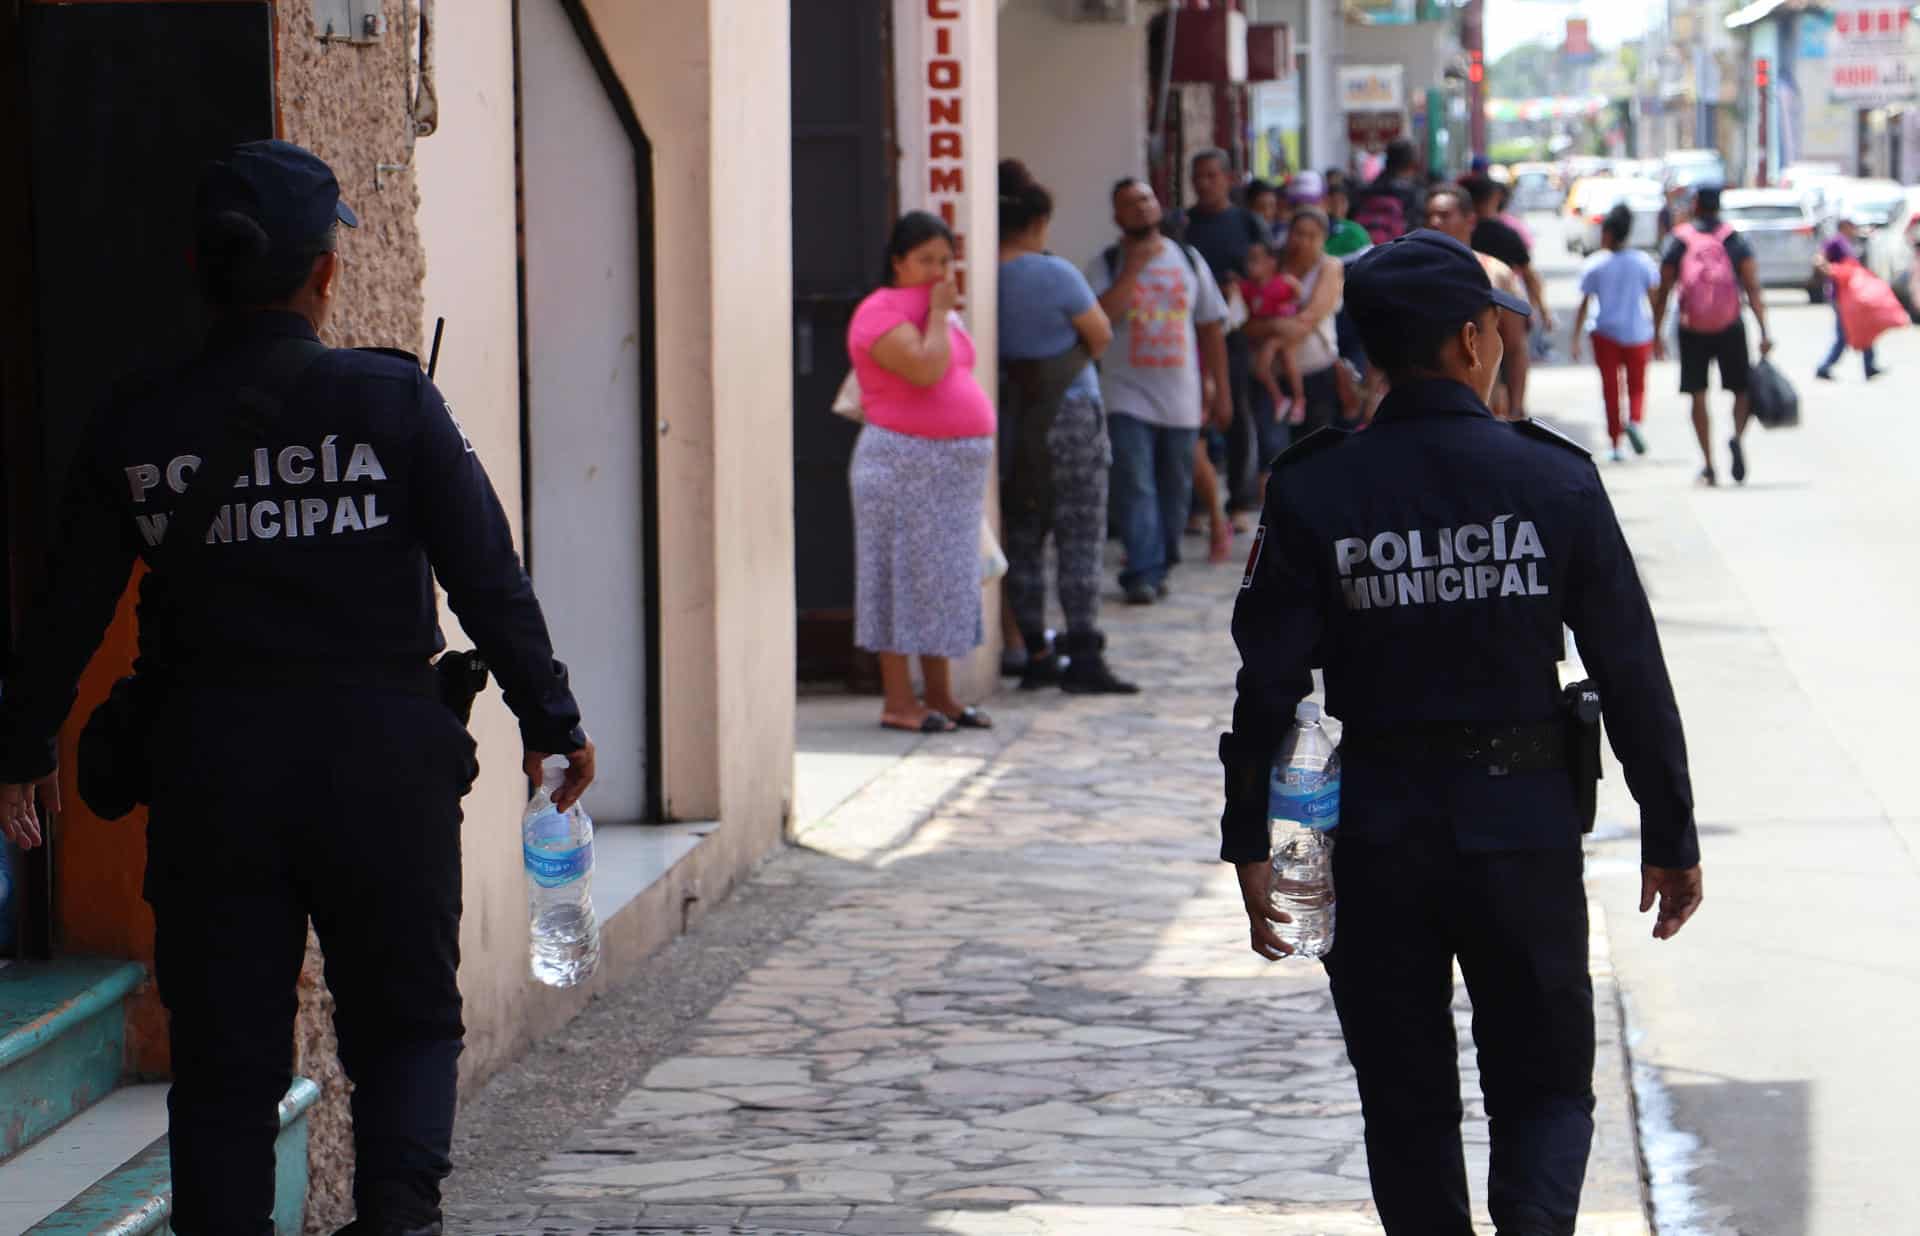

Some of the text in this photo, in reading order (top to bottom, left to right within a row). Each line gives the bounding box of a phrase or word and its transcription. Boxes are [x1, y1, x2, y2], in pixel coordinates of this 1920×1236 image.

[124, 435, 387, 502] POICÍA
[136, 494, 389, 546] MNICIPAL
[1335, 513, 1546, 576] POLICÍA
[1340, 561, 1549, 609] MUNICIPAL
